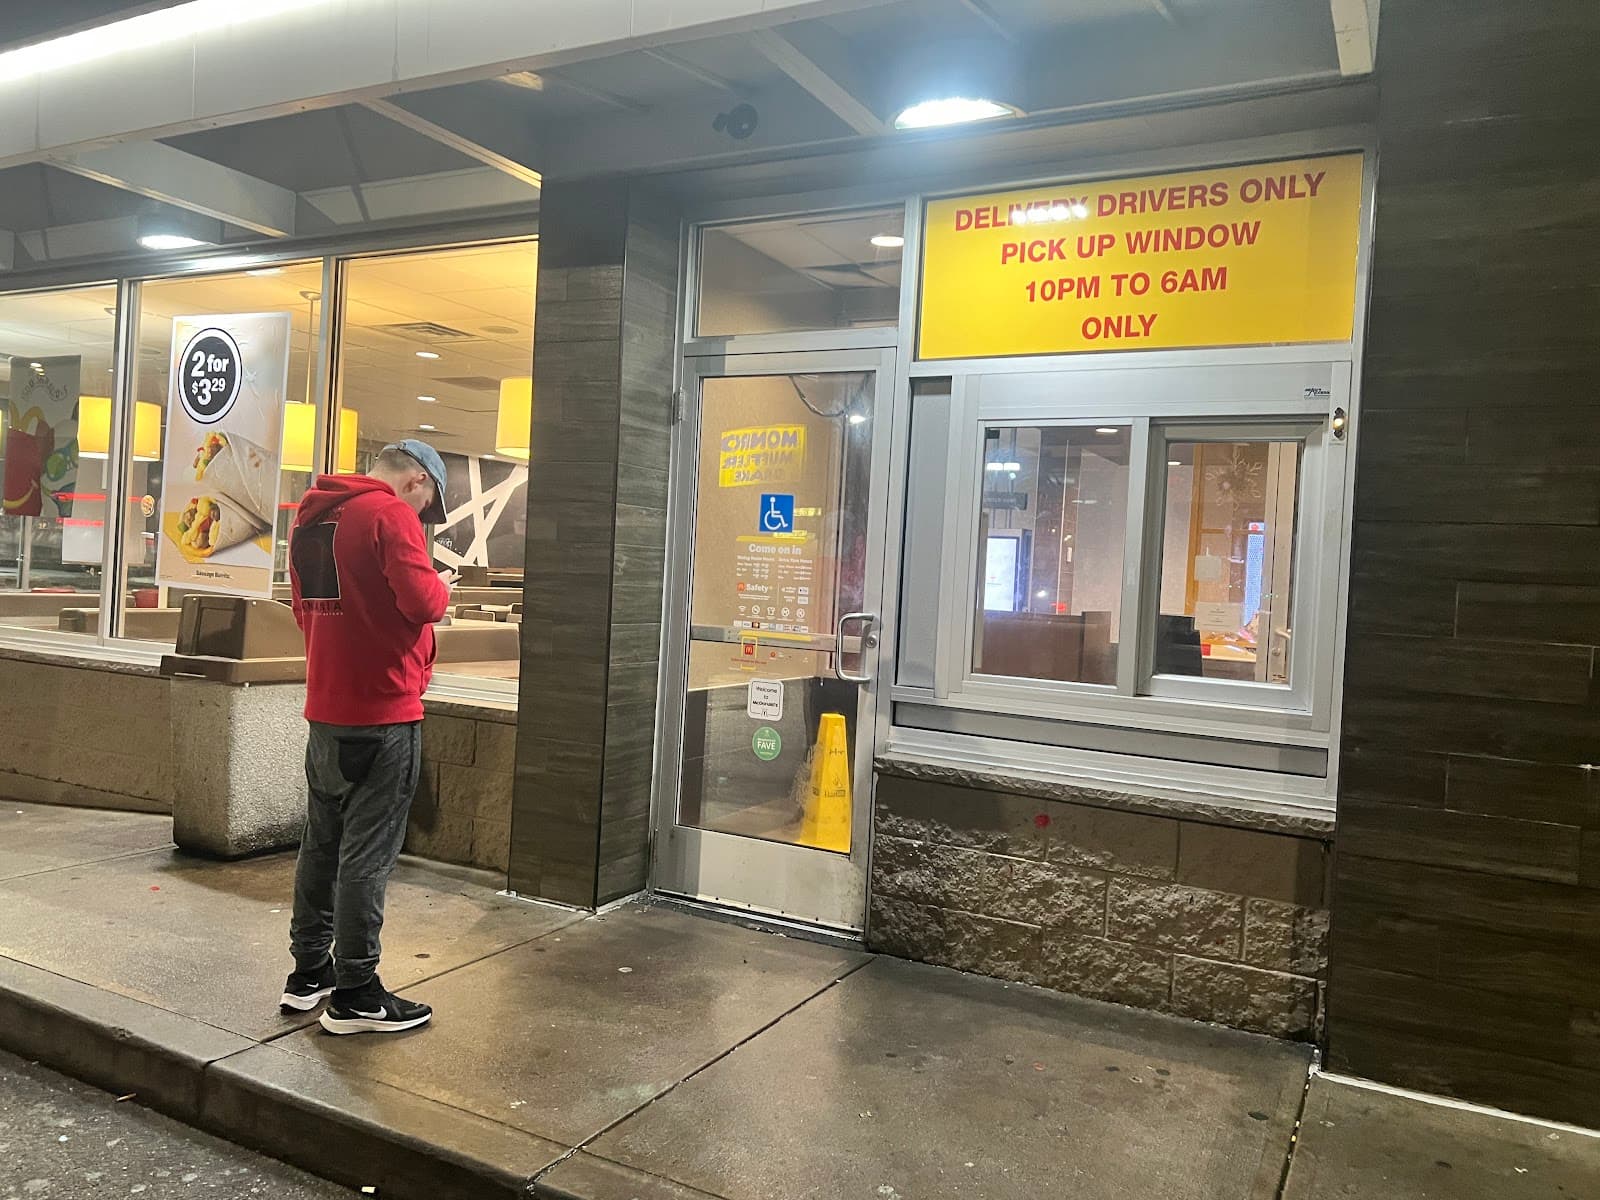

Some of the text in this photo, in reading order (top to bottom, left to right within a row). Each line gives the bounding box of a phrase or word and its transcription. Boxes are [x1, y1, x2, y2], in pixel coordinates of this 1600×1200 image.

[1096, 182, 1228, 217] DRIVERS
[1239, 172, 1326, 203] ONLY
[1001, 221, 1260, 265] PICK UP WINDOW
[1025, 266, 1227, 303] 10PM TO 6AM
[1081, 313, 1157, 340] ONLY
[191, 350, 230, 377] 2 for
[748, 543, 802, 555] Come on in
[757, 741, 776, 751] FAVE
